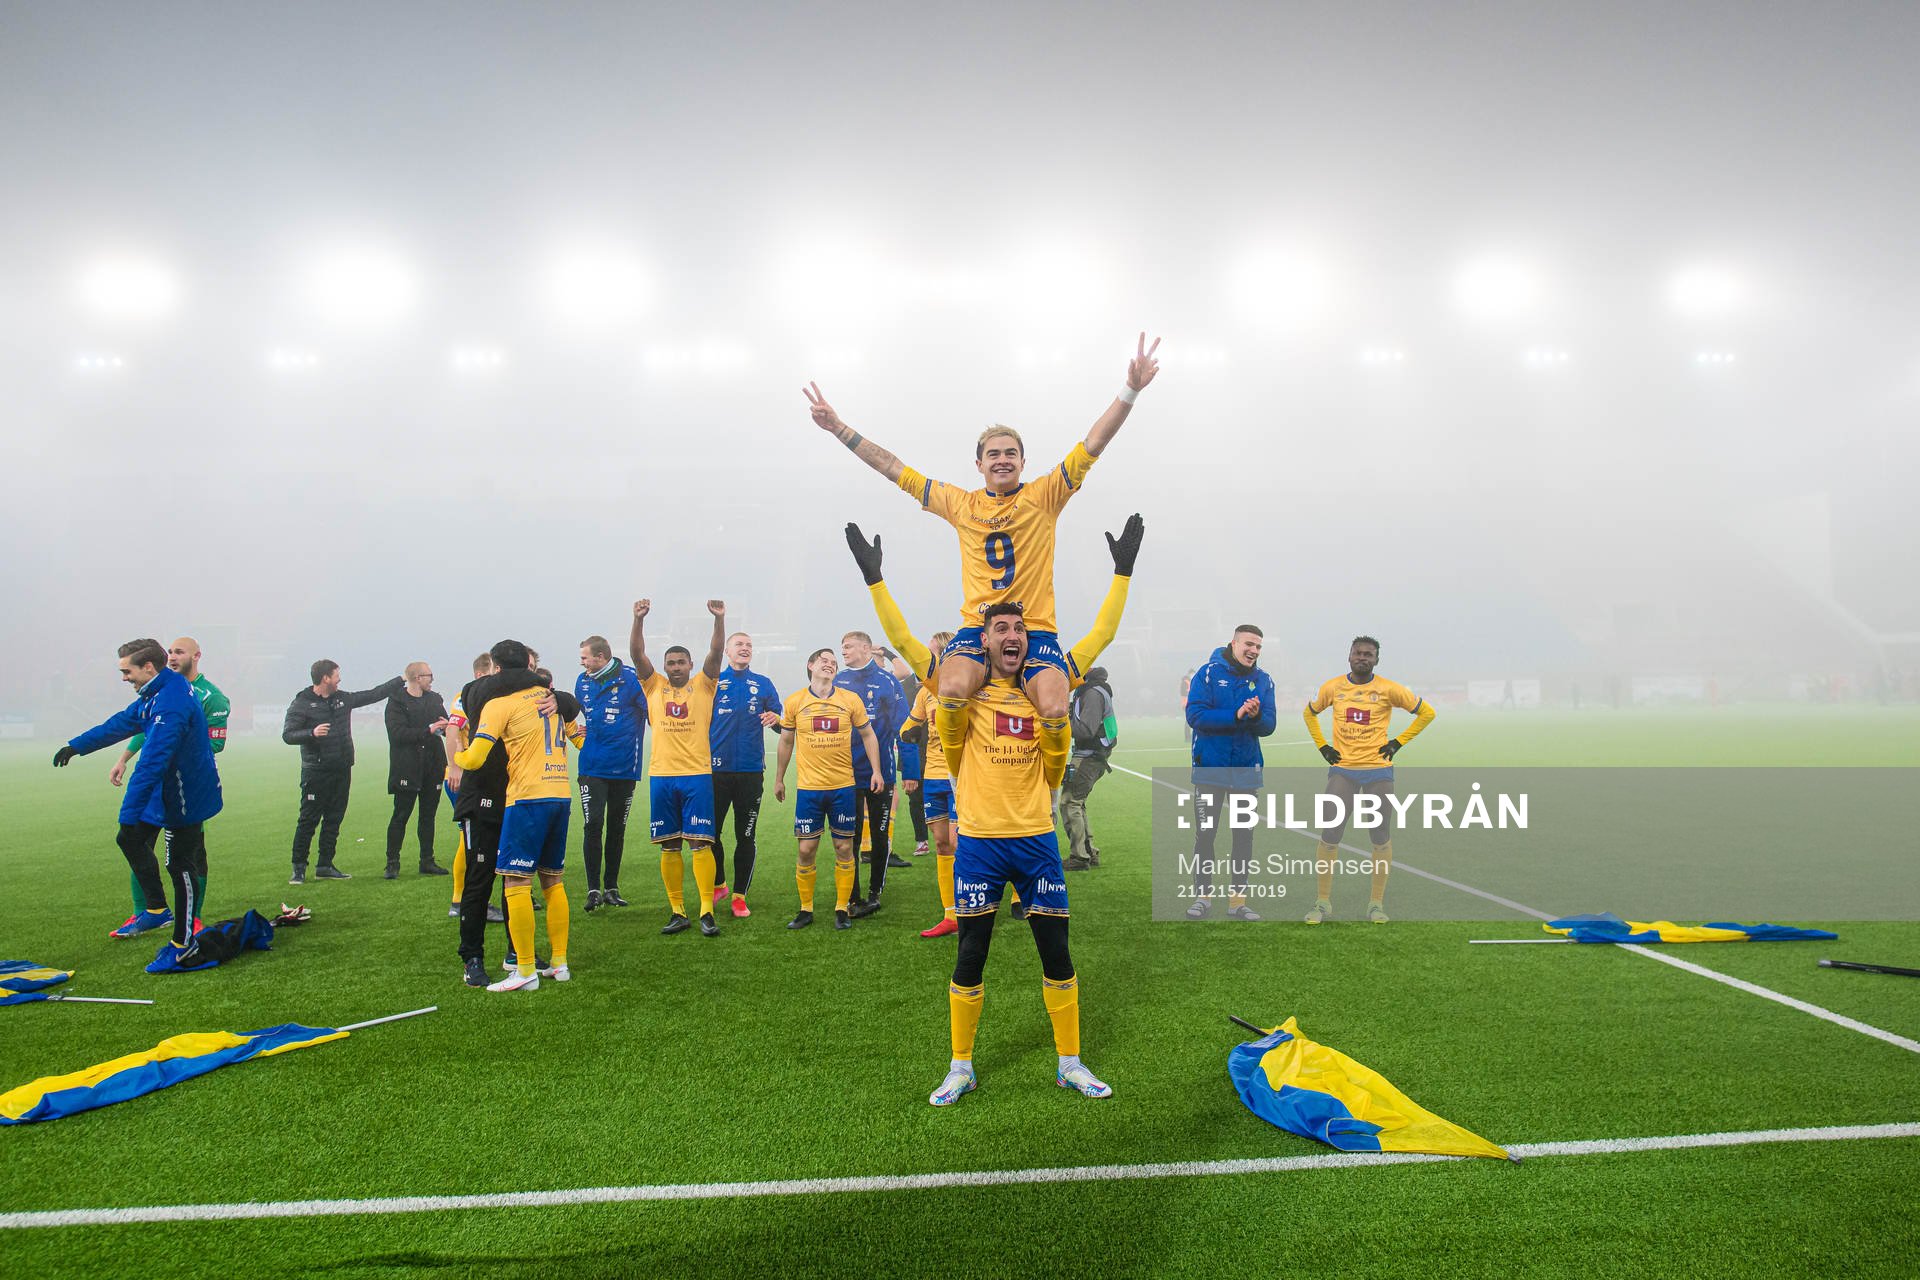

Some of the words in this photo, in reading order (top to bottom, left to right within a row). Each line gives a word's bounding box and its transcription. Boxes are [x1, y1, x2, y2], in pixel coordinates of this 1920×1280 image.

[985, 532, 1016, 590] 9
[672, 706, 681, 716] U
[1353, 712, 1363, 722] U
[821, 719, 831, 730] U
[1008, 717, 1023, 734] U
[538, 708, 567, 758] 14
[984, 745, 1000, 753] The
[1003, 746, 1015, 755] J.J.
[712, 757, 723, 767] 35
[480, 798, 493, 808] RB
[651, 827, 657, 838] 7
[801, 824, 811, 834] 18
[963, 882, 988, 891] NYMO
[1048, 883, 1066, 892] NYM
[968, 892, 986, 908] 39
